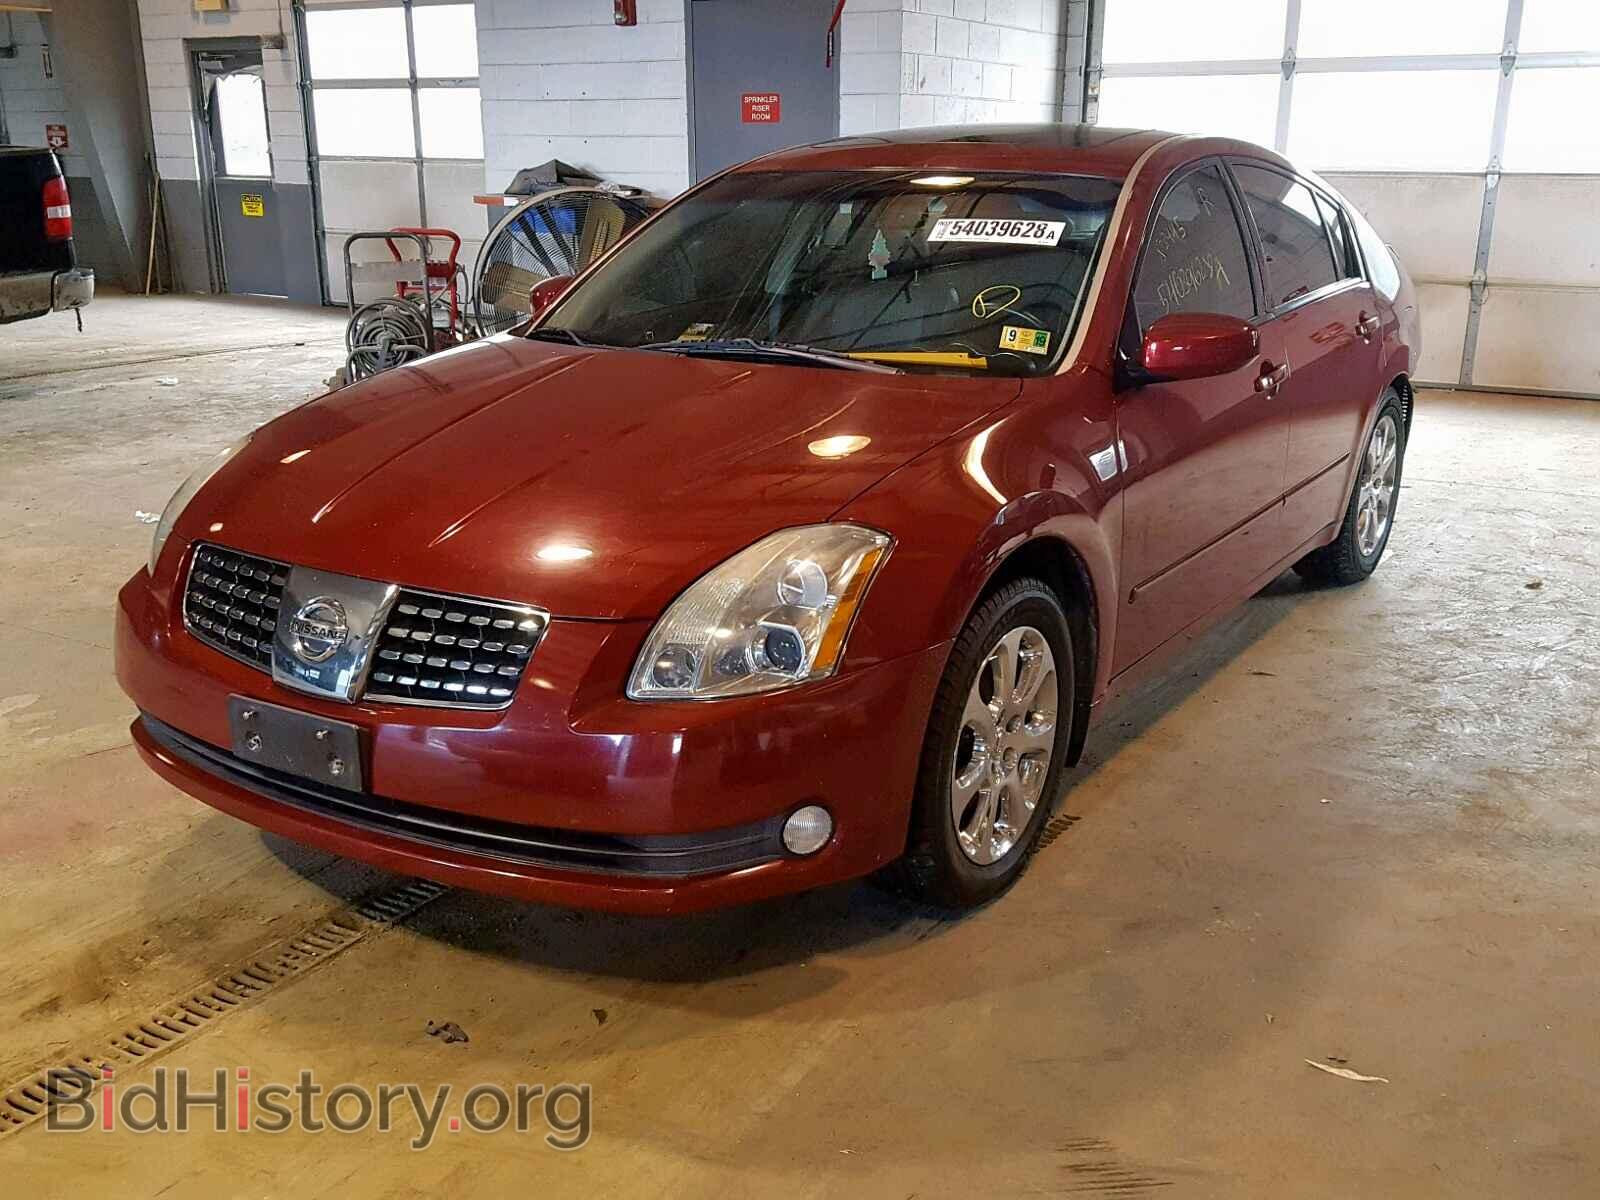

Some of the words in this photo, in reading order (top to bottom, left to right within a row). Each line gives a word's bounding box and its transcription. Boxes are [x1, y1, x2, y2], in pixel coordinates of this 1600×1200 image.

[752, 112, 771, 120] ROOM
[1008, 329, 1017, 342] 9
[293, 621, 339, 639] NISSAN
